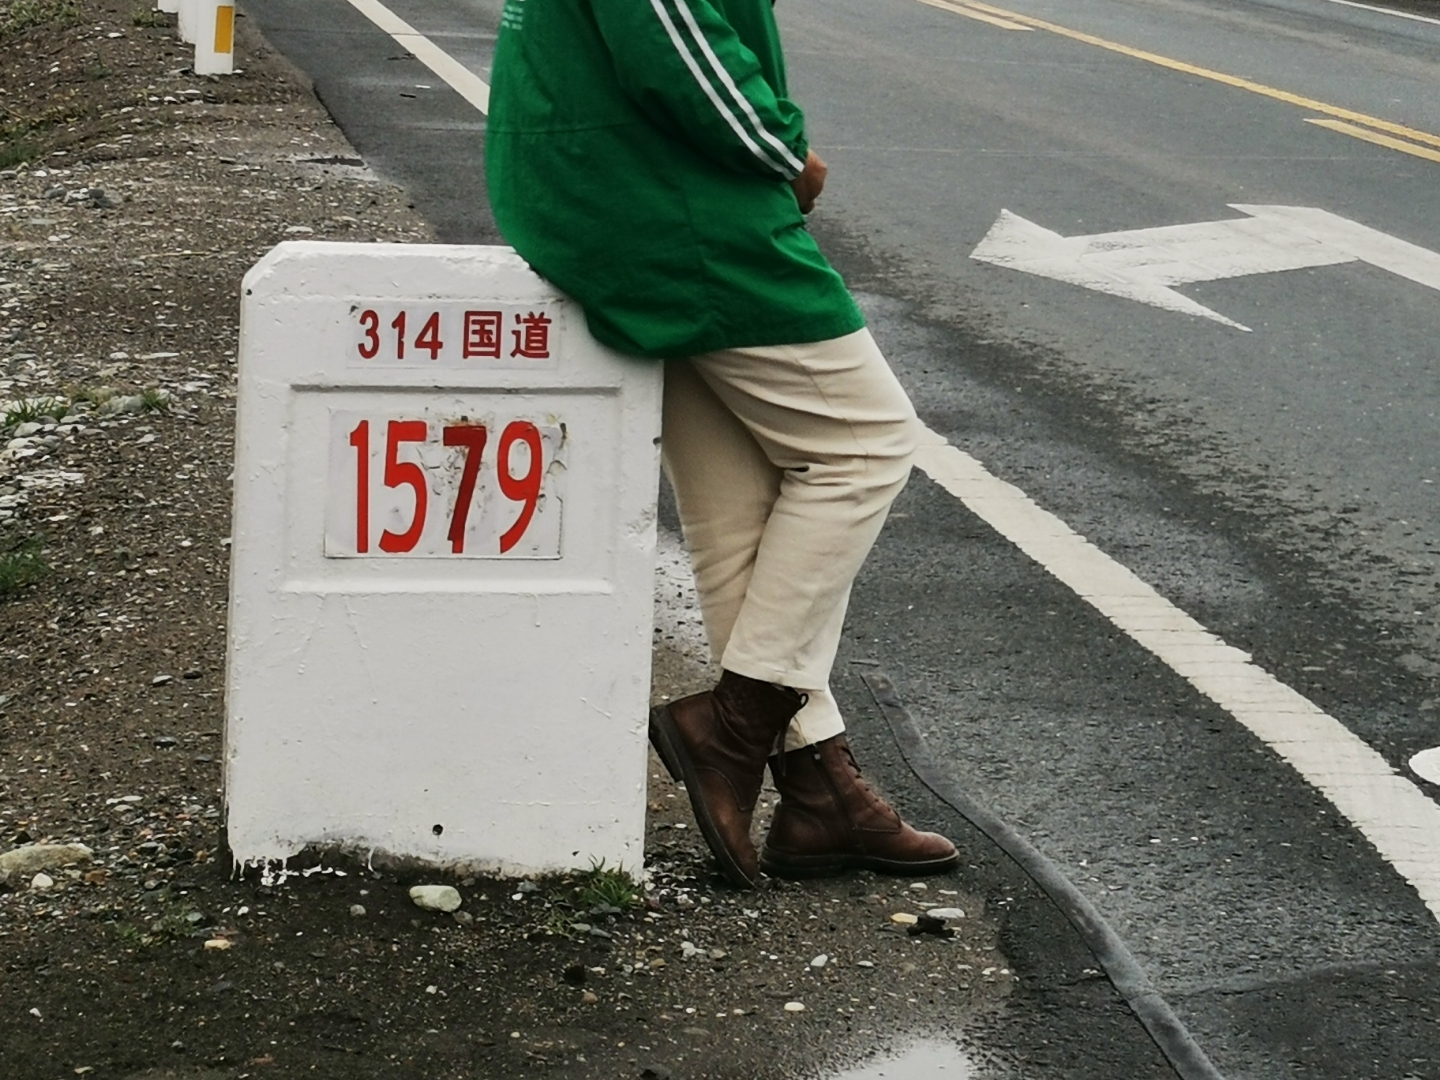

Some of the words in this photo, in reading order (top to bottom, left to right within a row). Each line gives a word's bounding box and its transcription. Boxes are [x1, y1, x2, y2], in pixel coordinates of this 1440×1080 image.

[358, 310, 443, 360] 314
[462, 310, 552, 360] 国道
[349, 420, 543, 554] 1579
